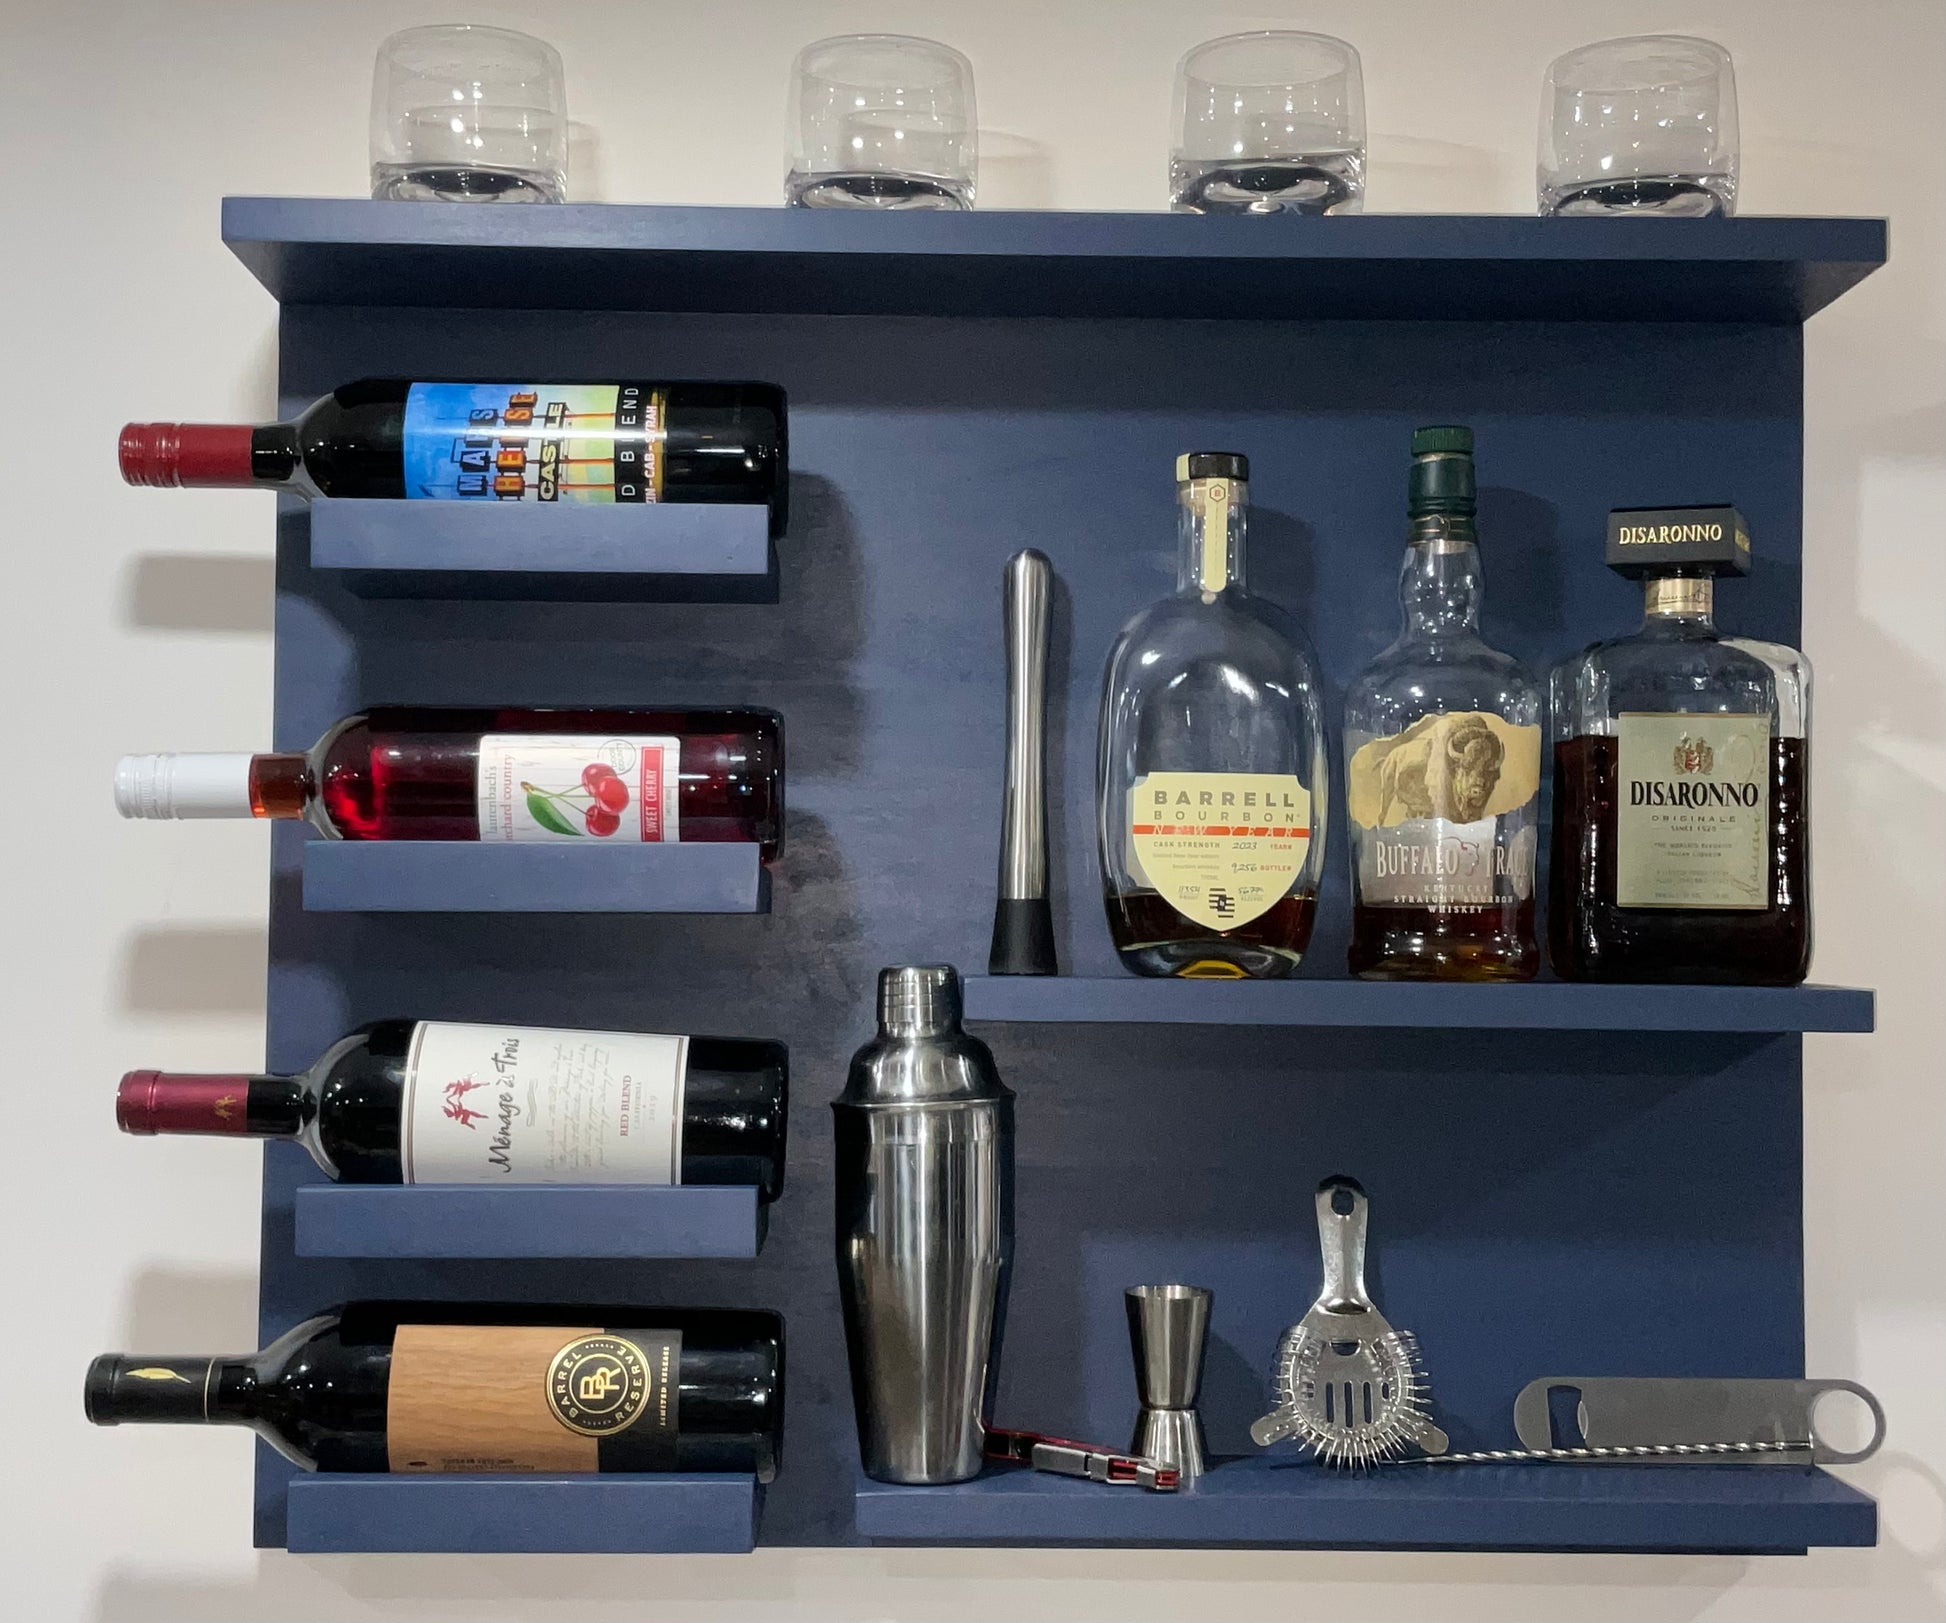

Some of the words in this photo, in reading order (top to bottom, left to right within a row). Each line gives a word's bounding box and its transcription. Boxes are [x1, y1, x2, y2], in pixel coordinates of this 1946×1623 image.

[1618, 524, 1723, 545] DISARONNO
[645, 768, 658, 802] CHERRY
[1153, 789, 1295, 808] BARRELL
[1630, 781, 1759, 809] DISARONNO
[645, 806, 659, 834] SWEET
[1153, 810, 1295, 823] BOURBON
[1651, 815, 1736, 823] ORIGINALE
[1153, 825, 1207, 836] NEW
[1228, 826, 1294, 837] YEAR
[1177, 841, 1221, 849] STRENGTH
[1375, 841, 1460, 878] BUFFALO
[1427, 905, 1483, 914] WHISKEY
[490, 1038, 521, 1074] Trois
[620, 1074, 632, 1112] BLEND
[488, 1092, 521, 1173] Ménage
[619, 1114, 630, 1137] RED
[661, 1346, 670, 1384] RELEASE
[557, 1352, 583, 1418] BARREL
[614, 1345, 642, 1422] RESERVE
[659, 1386, 668, 1427] LIMITED
